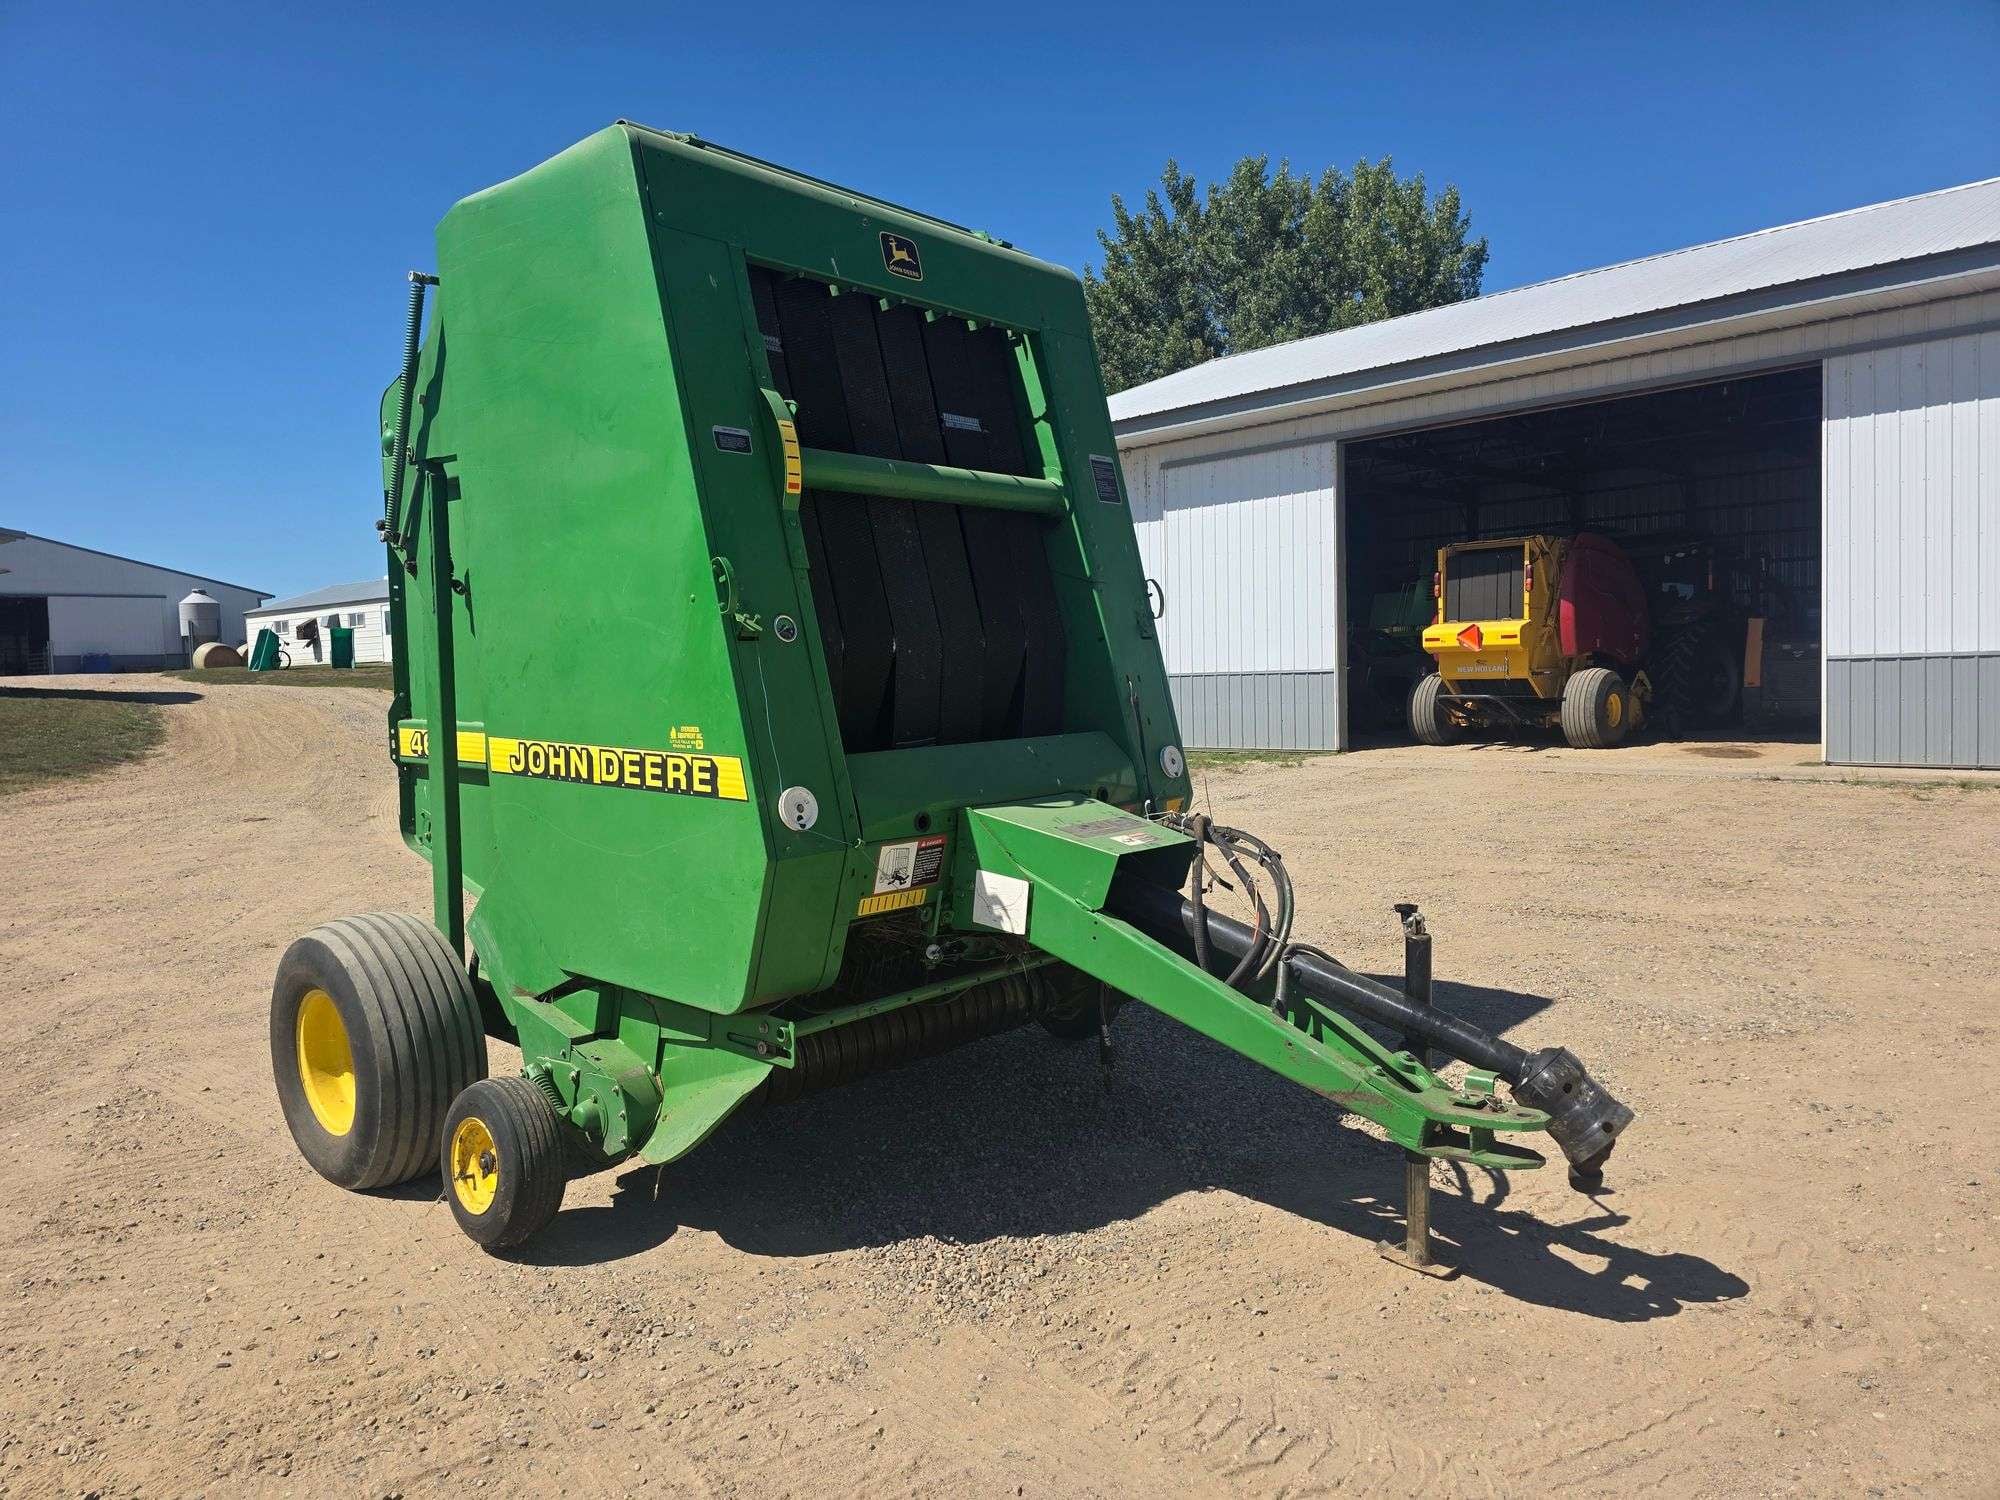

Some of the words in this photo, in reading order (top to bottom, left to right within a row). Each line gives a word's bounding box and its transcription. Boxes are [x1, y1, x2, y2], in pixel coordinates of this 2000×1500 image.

[1456, 665, 1473, 673] NEW
[510, 742, 591, 781] JOHN
[597, 750, 718, 795] DEERE
